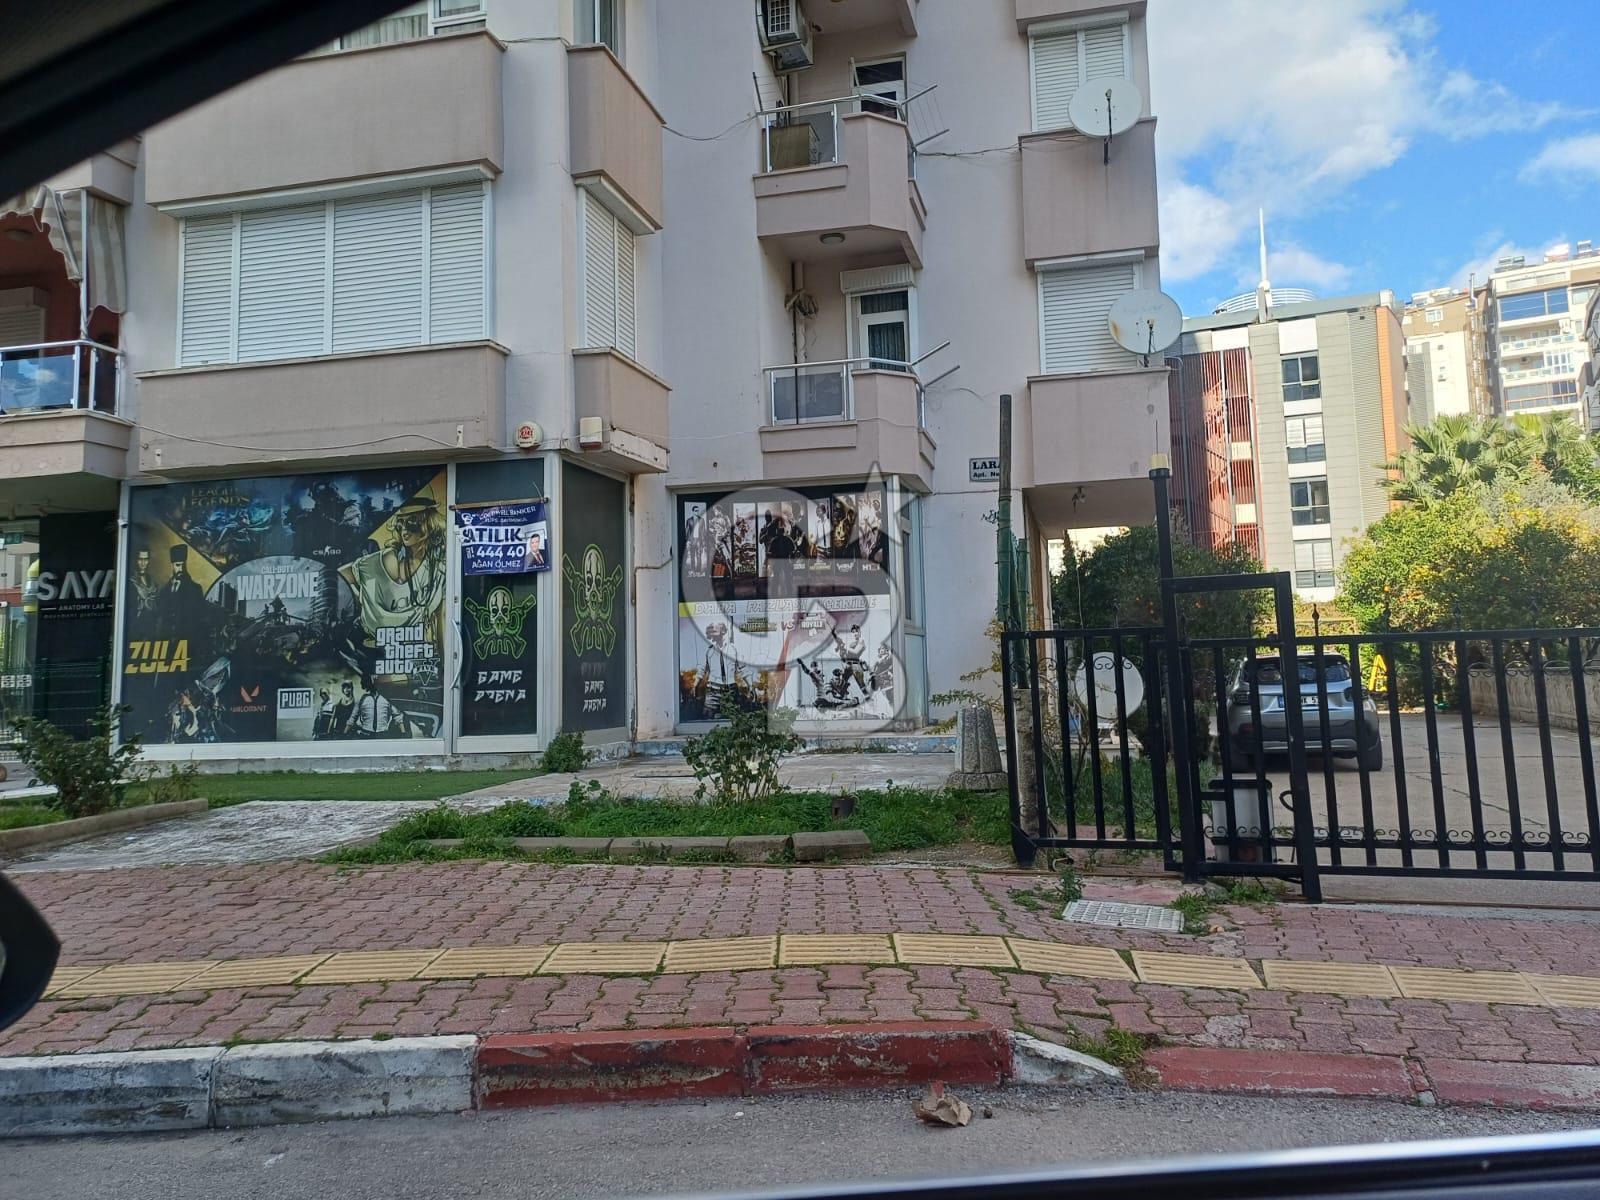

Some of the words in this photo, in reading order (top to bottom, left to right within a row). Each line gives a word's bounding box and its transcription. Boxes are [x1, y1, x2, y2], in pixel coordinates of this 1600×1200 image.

[477, 546, 503, 558] 444
[237, 572, 319, 600] WARZONE
[125, 640, 188, 673] ZULA
[477, 670, 523, 684] GAME
[281, 692, 310, 708] PUBG
